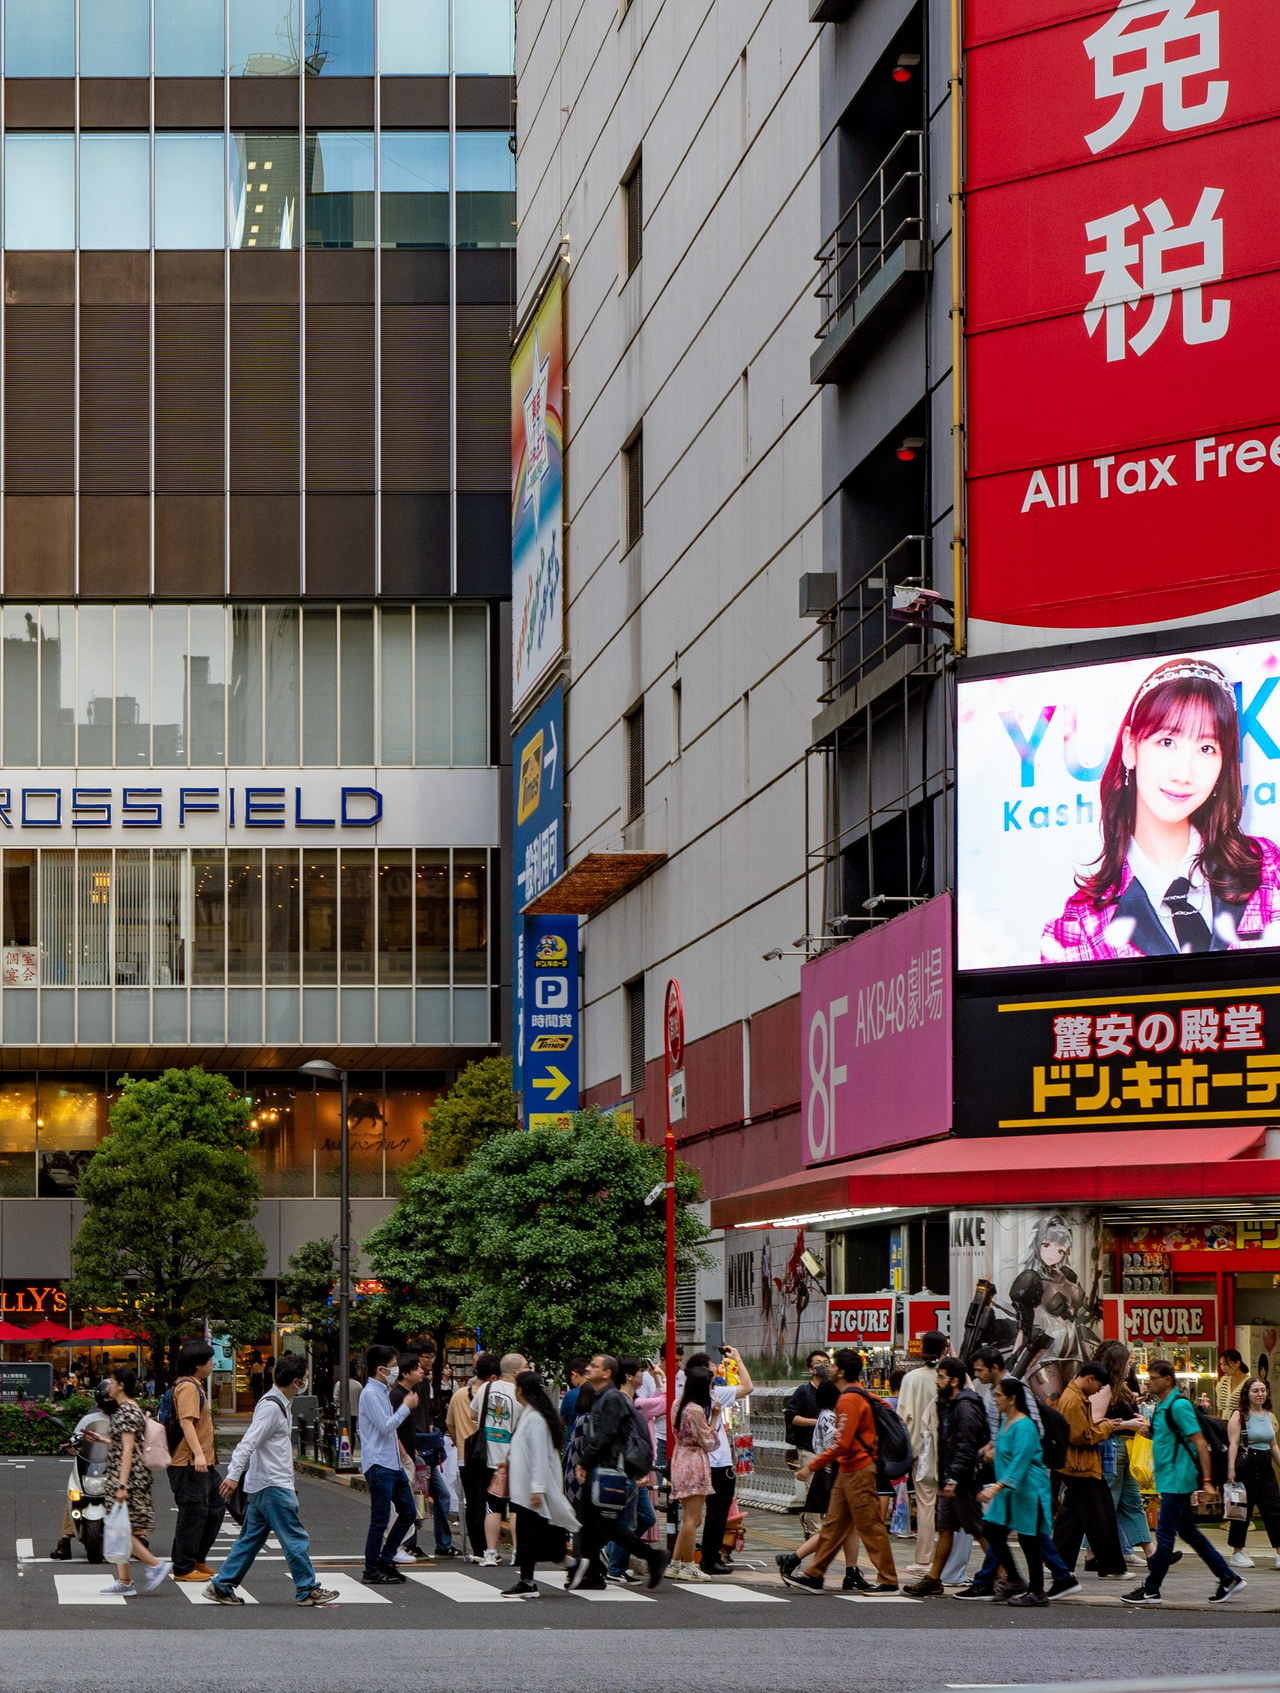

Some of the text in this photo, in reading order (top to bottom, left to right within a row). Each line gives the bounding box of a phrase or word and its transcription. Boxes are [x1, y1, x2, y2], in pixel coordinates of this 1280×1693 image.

[1083, 0, 1231, 363] 免税
[1021, 463, 1078, 513] All
[1093, 454, 1178, 499] Tax
[541, 980, 562, 1005] P
[531, 1013, 573, 1029] 時間貸
[1053, 1004, 1265, 1060] 驚安の殿堂
[537, 1038, 568, 1050] Times
[808, 947, 943, 1161] 8F AKB48劇場
[830, 1309, 890, 1333] FIGURE
[1130, 1307, 1204, 1336] FIGURE
